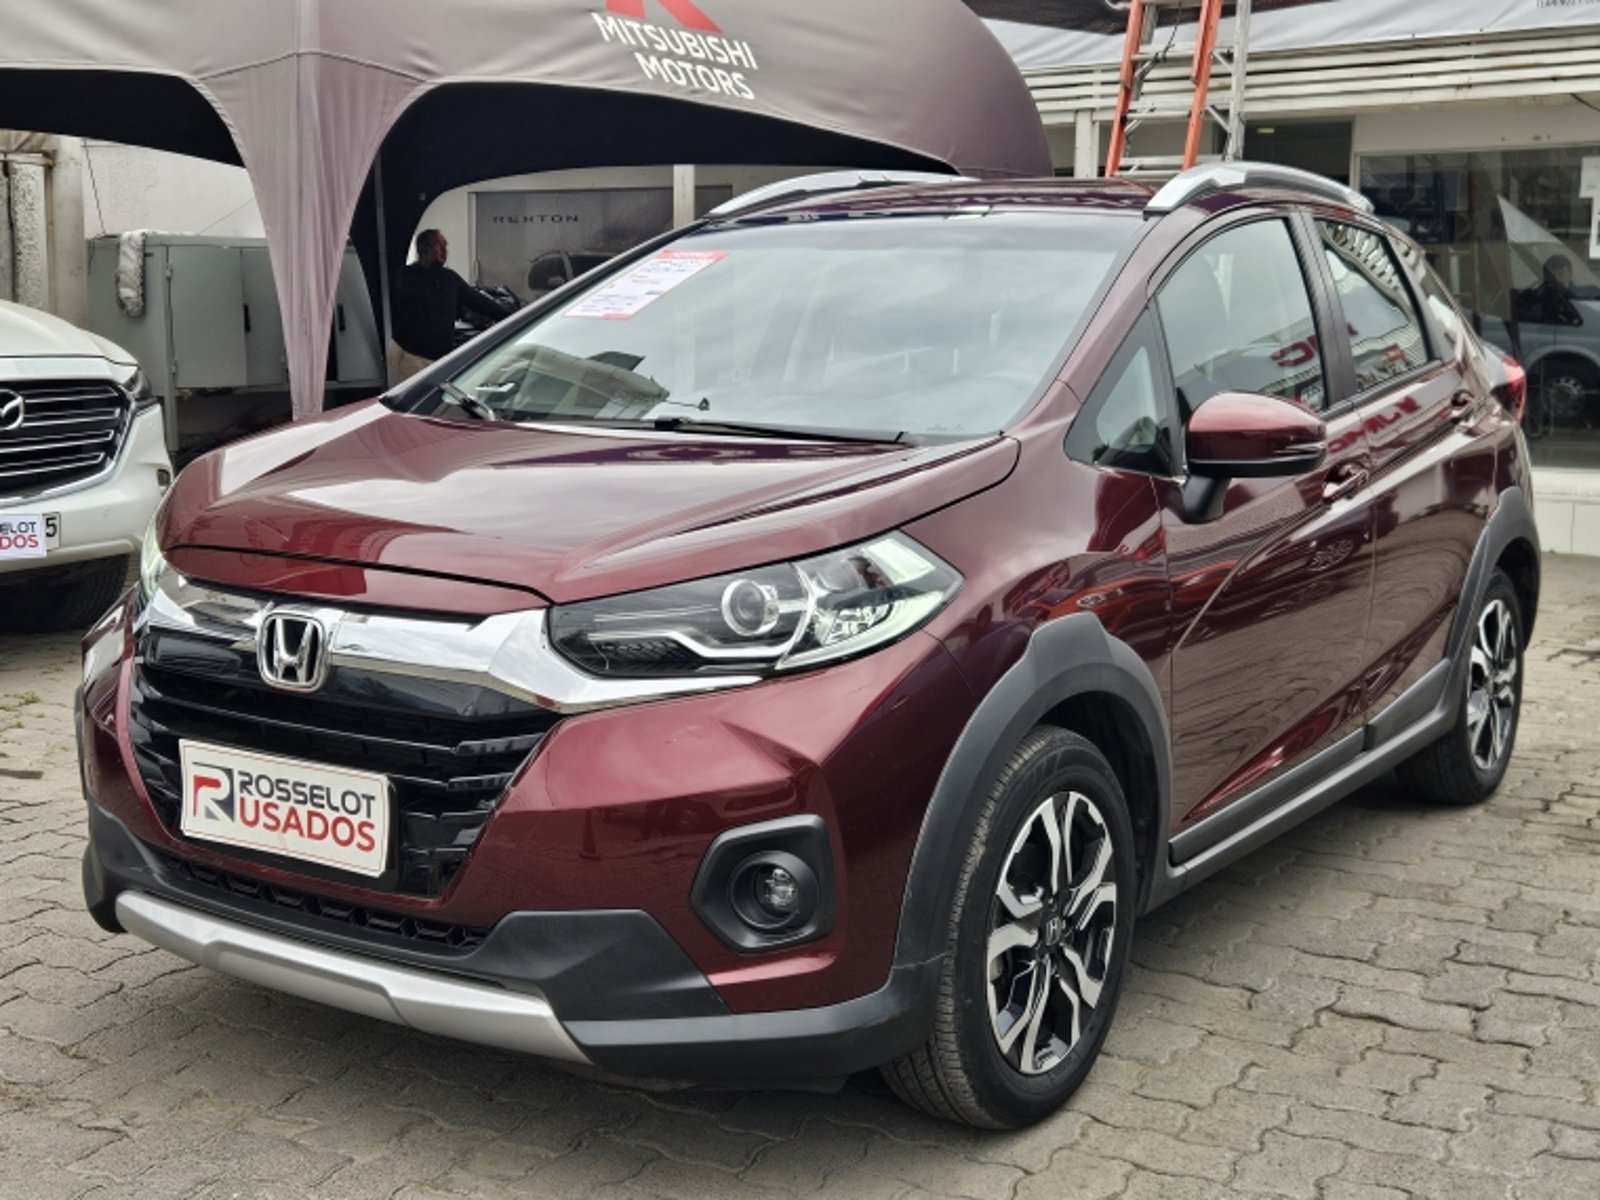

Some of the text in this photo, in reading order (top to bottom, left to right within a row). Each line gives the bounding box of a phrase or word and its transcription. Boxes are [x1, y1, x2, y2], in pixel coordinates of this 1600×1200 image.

[591, 12, 759, 70] MITSUBISHI
[634, 51, 755, 100] MOTORS
[45, 516, 58, 538] 5
[237, 769, 376, 819] ROSSELOT
[239, 796, 376, 853] USADOS
